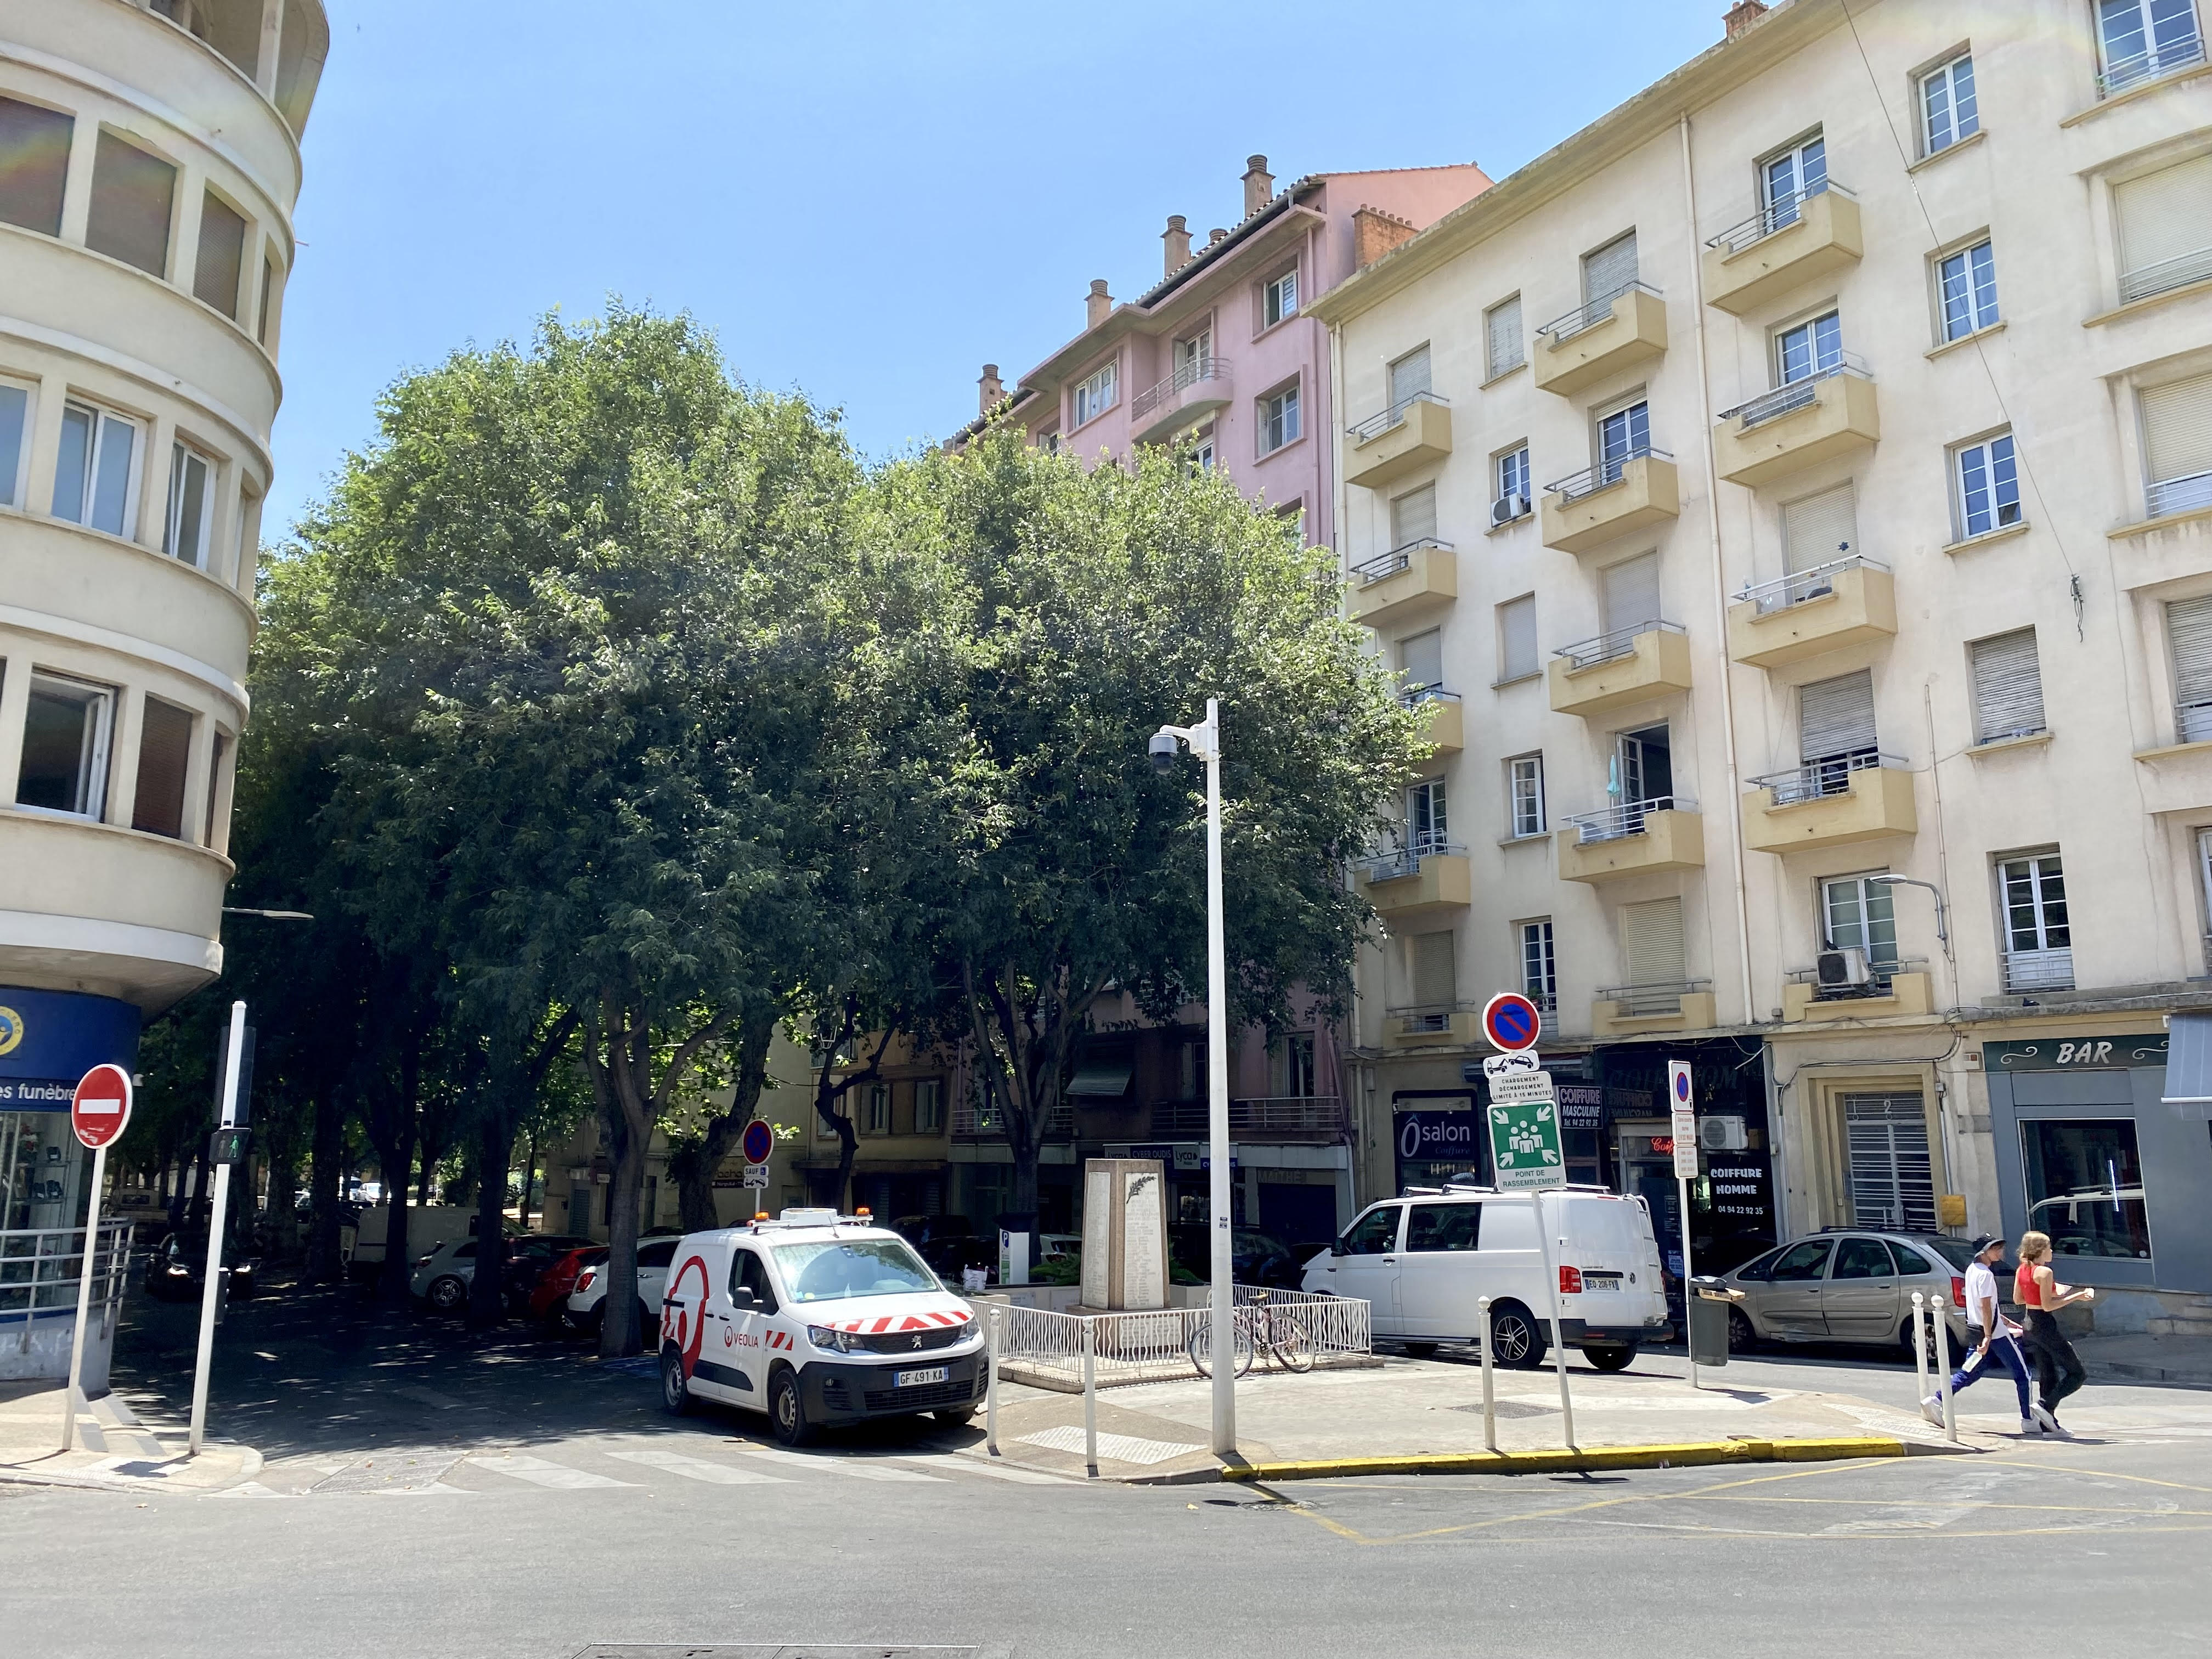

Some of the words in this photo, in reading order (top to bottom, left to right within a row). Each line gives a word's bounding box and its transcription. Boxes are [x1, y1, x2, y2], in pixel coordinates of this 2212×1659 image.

[2056, 1041, 2113, 1064] BAR
[1502, 1076, 1539, 1084] CHARGEMENT
[18, 1083, 75, 1101] funèbre
[1499, 1083, 1544, 1092] DÉCHARGEMENT
[1560, 1088, 1600, 1104] COIFFURE
[1562, 1105, 1600, 1117] MASCULINE
[1422, 1121, 1470, 1141] salon
[1132, 1150, 1152, 1159] CYBER
[1153, 1150, 1172, 1159] OUDIS
[1175, 1150, 1193, 1163] Lyca
[1435, 1146, 1470, 1156] Coiffure
[1711, 1169, 1762, 1178] COIFFURE
[1503, 1177, 1560, 1187] RASSEMBLEMENT
[1716, 1185, 1757, 1194] HOMME
[734, 1333, 759, 1348] VEOLIA
